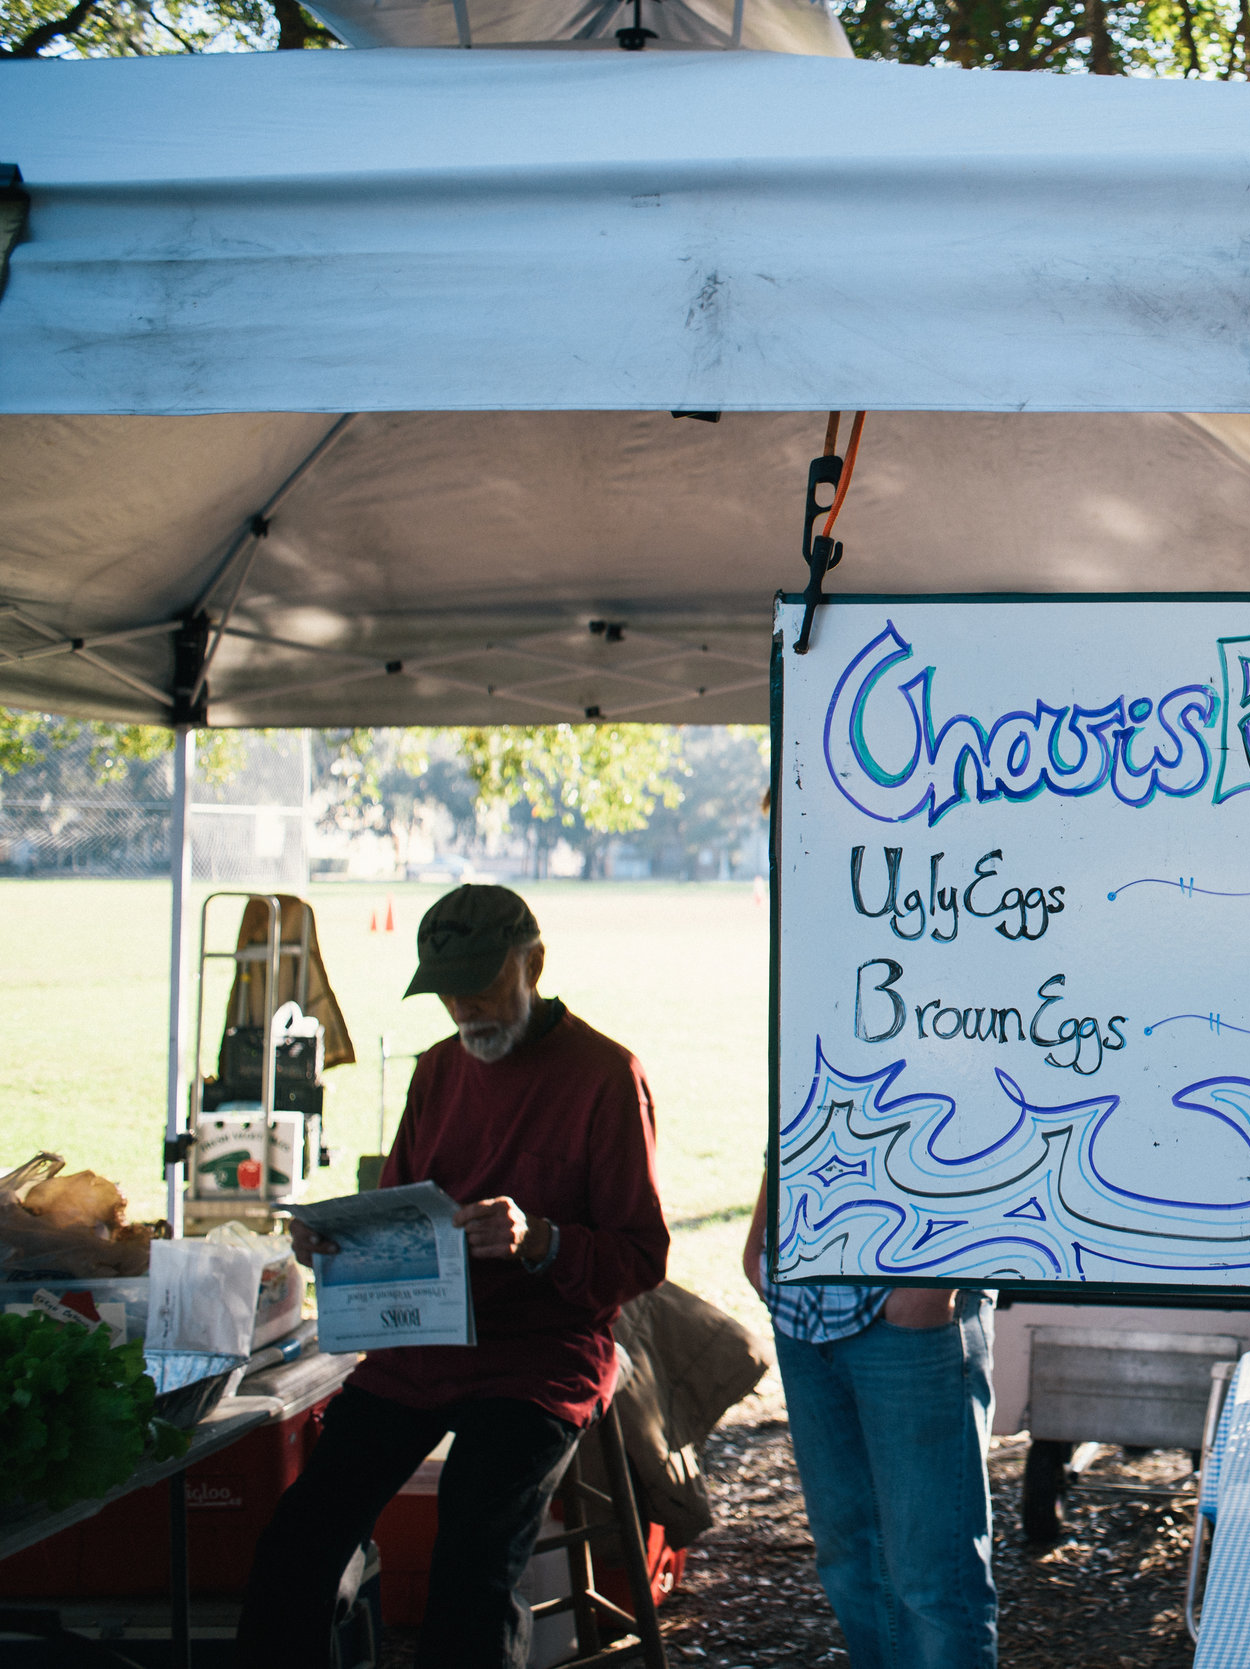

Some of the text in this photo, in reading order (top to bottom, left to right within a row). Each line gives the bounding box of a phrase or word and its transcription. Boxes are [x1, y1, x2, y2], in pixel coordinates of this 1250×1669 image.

[850, 845, 960, 942] Ugly
[963, 848, 1066, 941] Eggs
[855, 957, 1027, 1044] Brown
[1029, 973, 1128, 1075] Eggs
[380, 1308, 422, 1329] BOOKS
